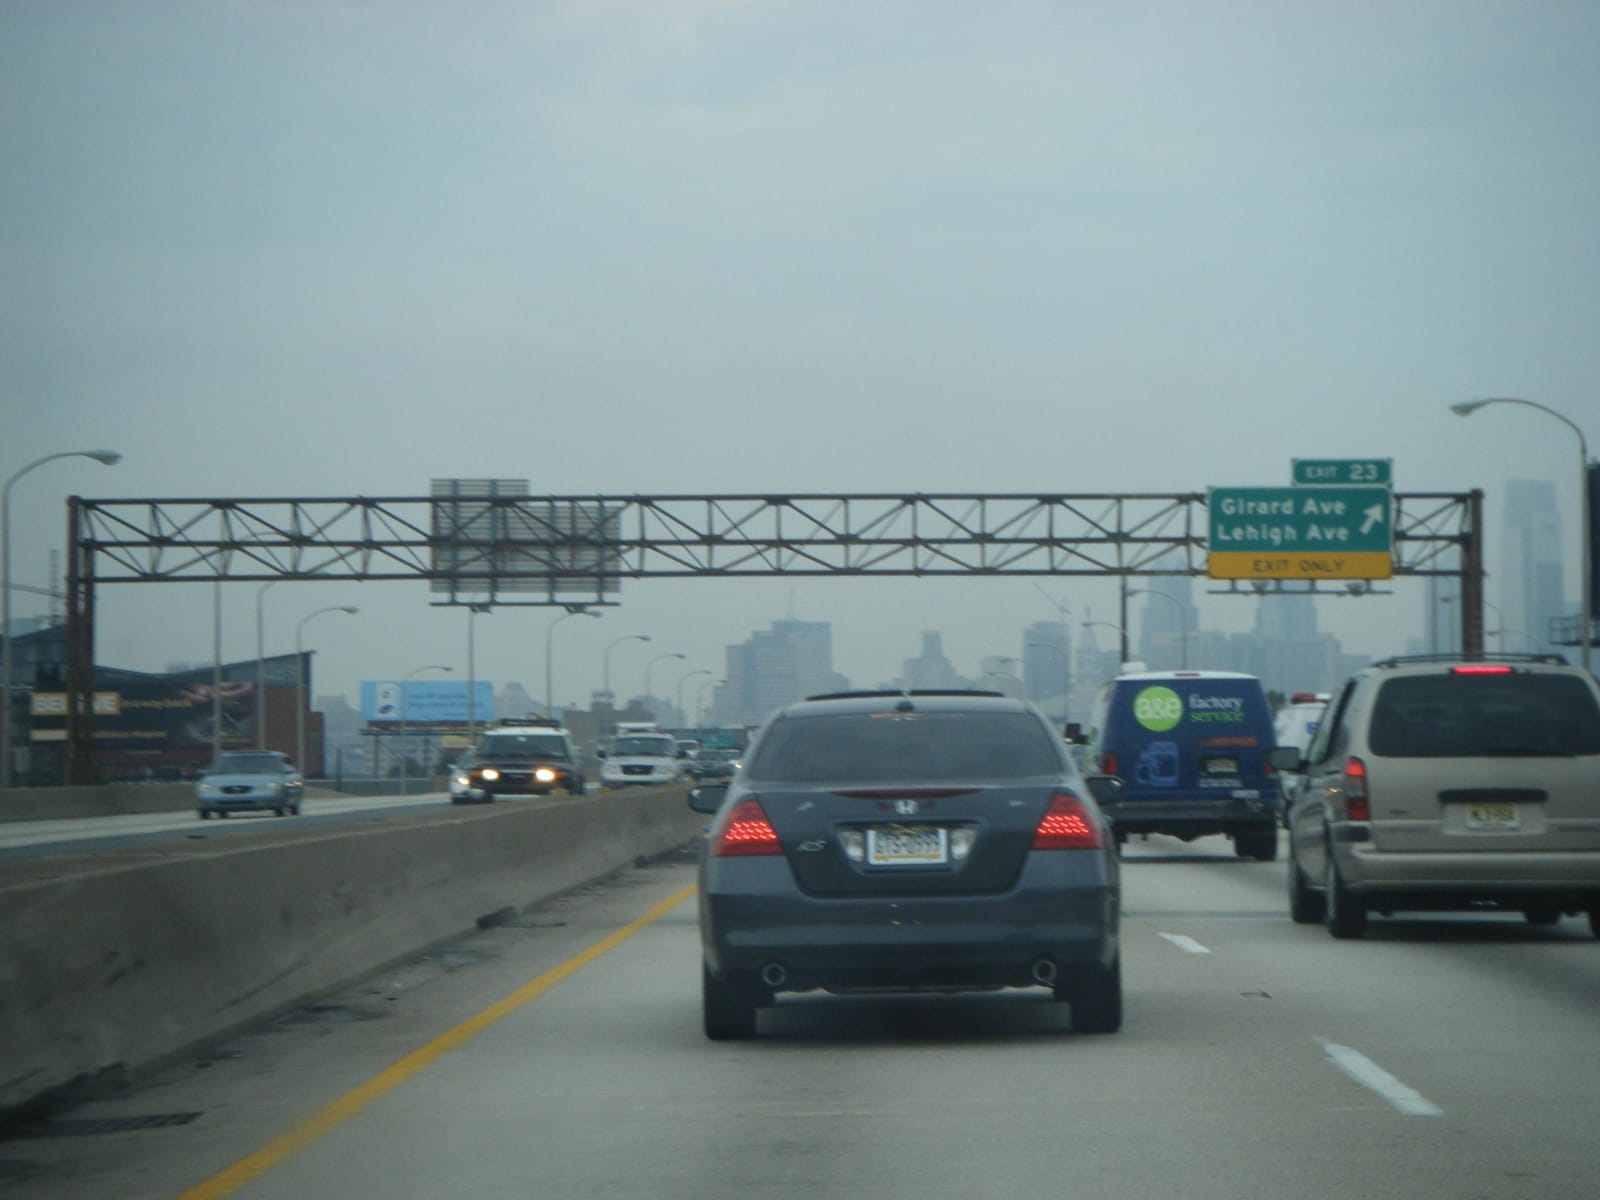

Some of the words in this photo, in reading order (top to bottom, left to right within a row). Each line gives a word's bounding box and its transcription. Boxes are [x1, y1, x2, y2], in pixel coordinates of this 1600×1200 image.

[1305, 465, 1338, 479] EXIT
[1349, 464, 1378, 480] 23
[1220, 498, 1294, 515] Girard
[1302, 498, 1346, 515] Ave
[1217, 524, 1297, 546] Lehigh
[1305, 524, 1349, 541] Ave
[1253, 559, 1289, 573] EXIT
[1299, 559, 1345, 573] ONLY
[1189, 694, 1244, 711] factory
[1191, 711, 1245, 722] service
